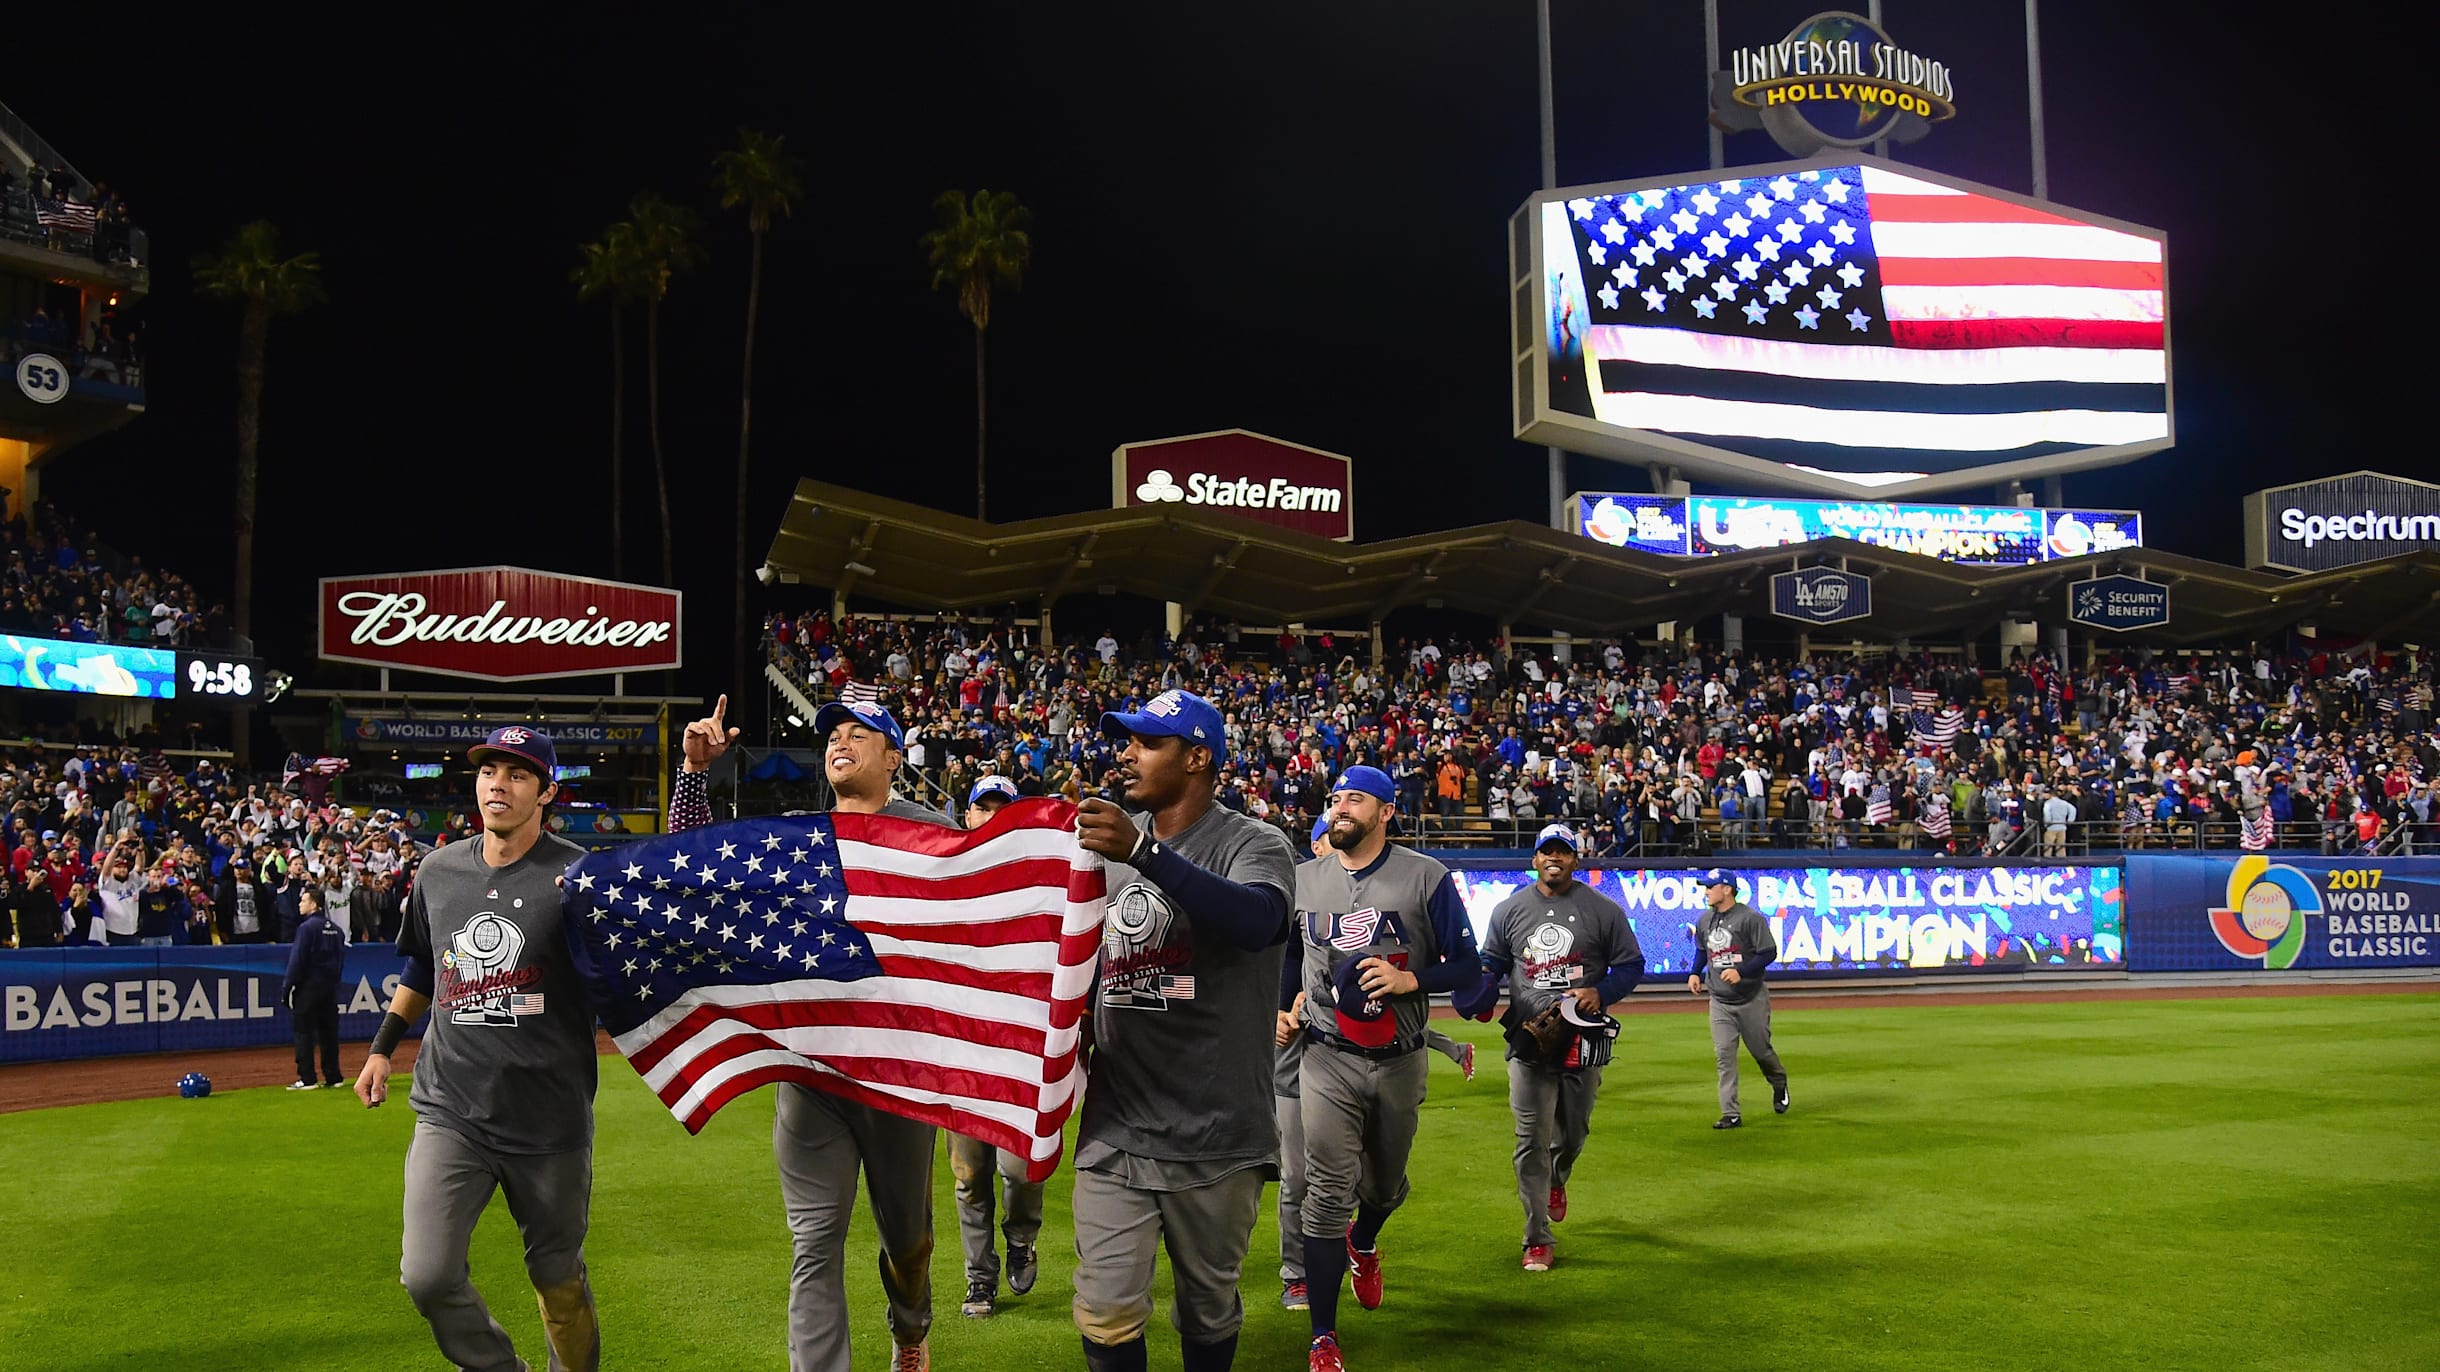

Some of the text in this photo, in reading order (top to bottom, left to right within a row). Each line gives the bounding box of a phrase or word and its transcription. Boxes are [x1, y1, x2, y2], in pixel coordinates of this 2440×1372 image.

[1733, 40, 1953, 103] UNIVERSAL STUDIOS
[1767, 83, 1931, 117] HOLLYWOOD
[27, 364, 59, 391] 53
[2281, 508, 2440, 548] Spectrum
[1814, 584, 1848, 601] AM570
[2108, 591, 2163, 604] SECURITY
[338, 592, 671, 647] Budweiser
[188, 660, 252, 695] 9:58
[386, 724, 446, 737] WORLD
[605, 728, 644, 740] 2017
[1619, 874, 2067, 911] WORD BASEBALL CLASSIC
[2327, 869, 2382, 889] 2017
[2326, 892, 2410, 911] WORLD
[1305, 907, 1408, 951] USA
[2328, 914, 2440, 934] BASEBALL
[1770, 913, 1987, 967] AMPION
[2328, 937, 2427, 957] CLASSIC
[1134, 965, 1166, 978] STATES
[5, 977, 274, 1032] BASEBALL
[451, 986, 518, 1006] UNITED STATES
